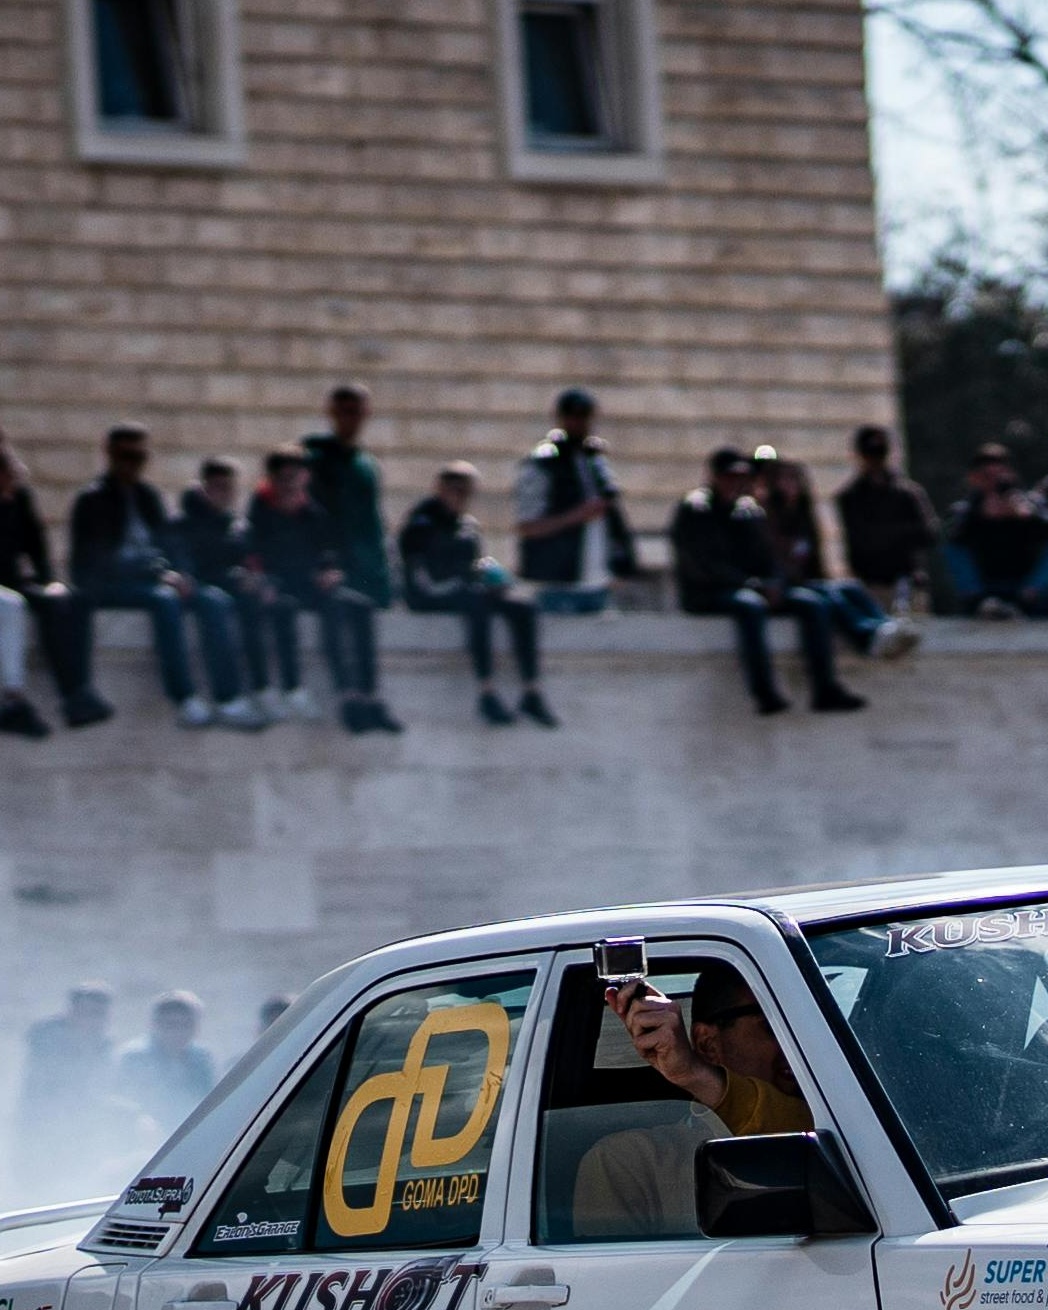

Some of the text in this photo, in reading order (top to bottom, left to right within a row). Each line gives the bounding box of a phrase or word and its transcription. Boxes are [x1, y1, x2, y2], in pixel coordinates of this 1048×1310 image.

[402, 1174, 480, 1211] GOMA DPD
[984, 1260, 1047, 1284] SUPER
[980, 1291, 1009, 1305] street
[1011, 1290, 1035, 1304] food
[1036, 1290, 1044, 1304] &
